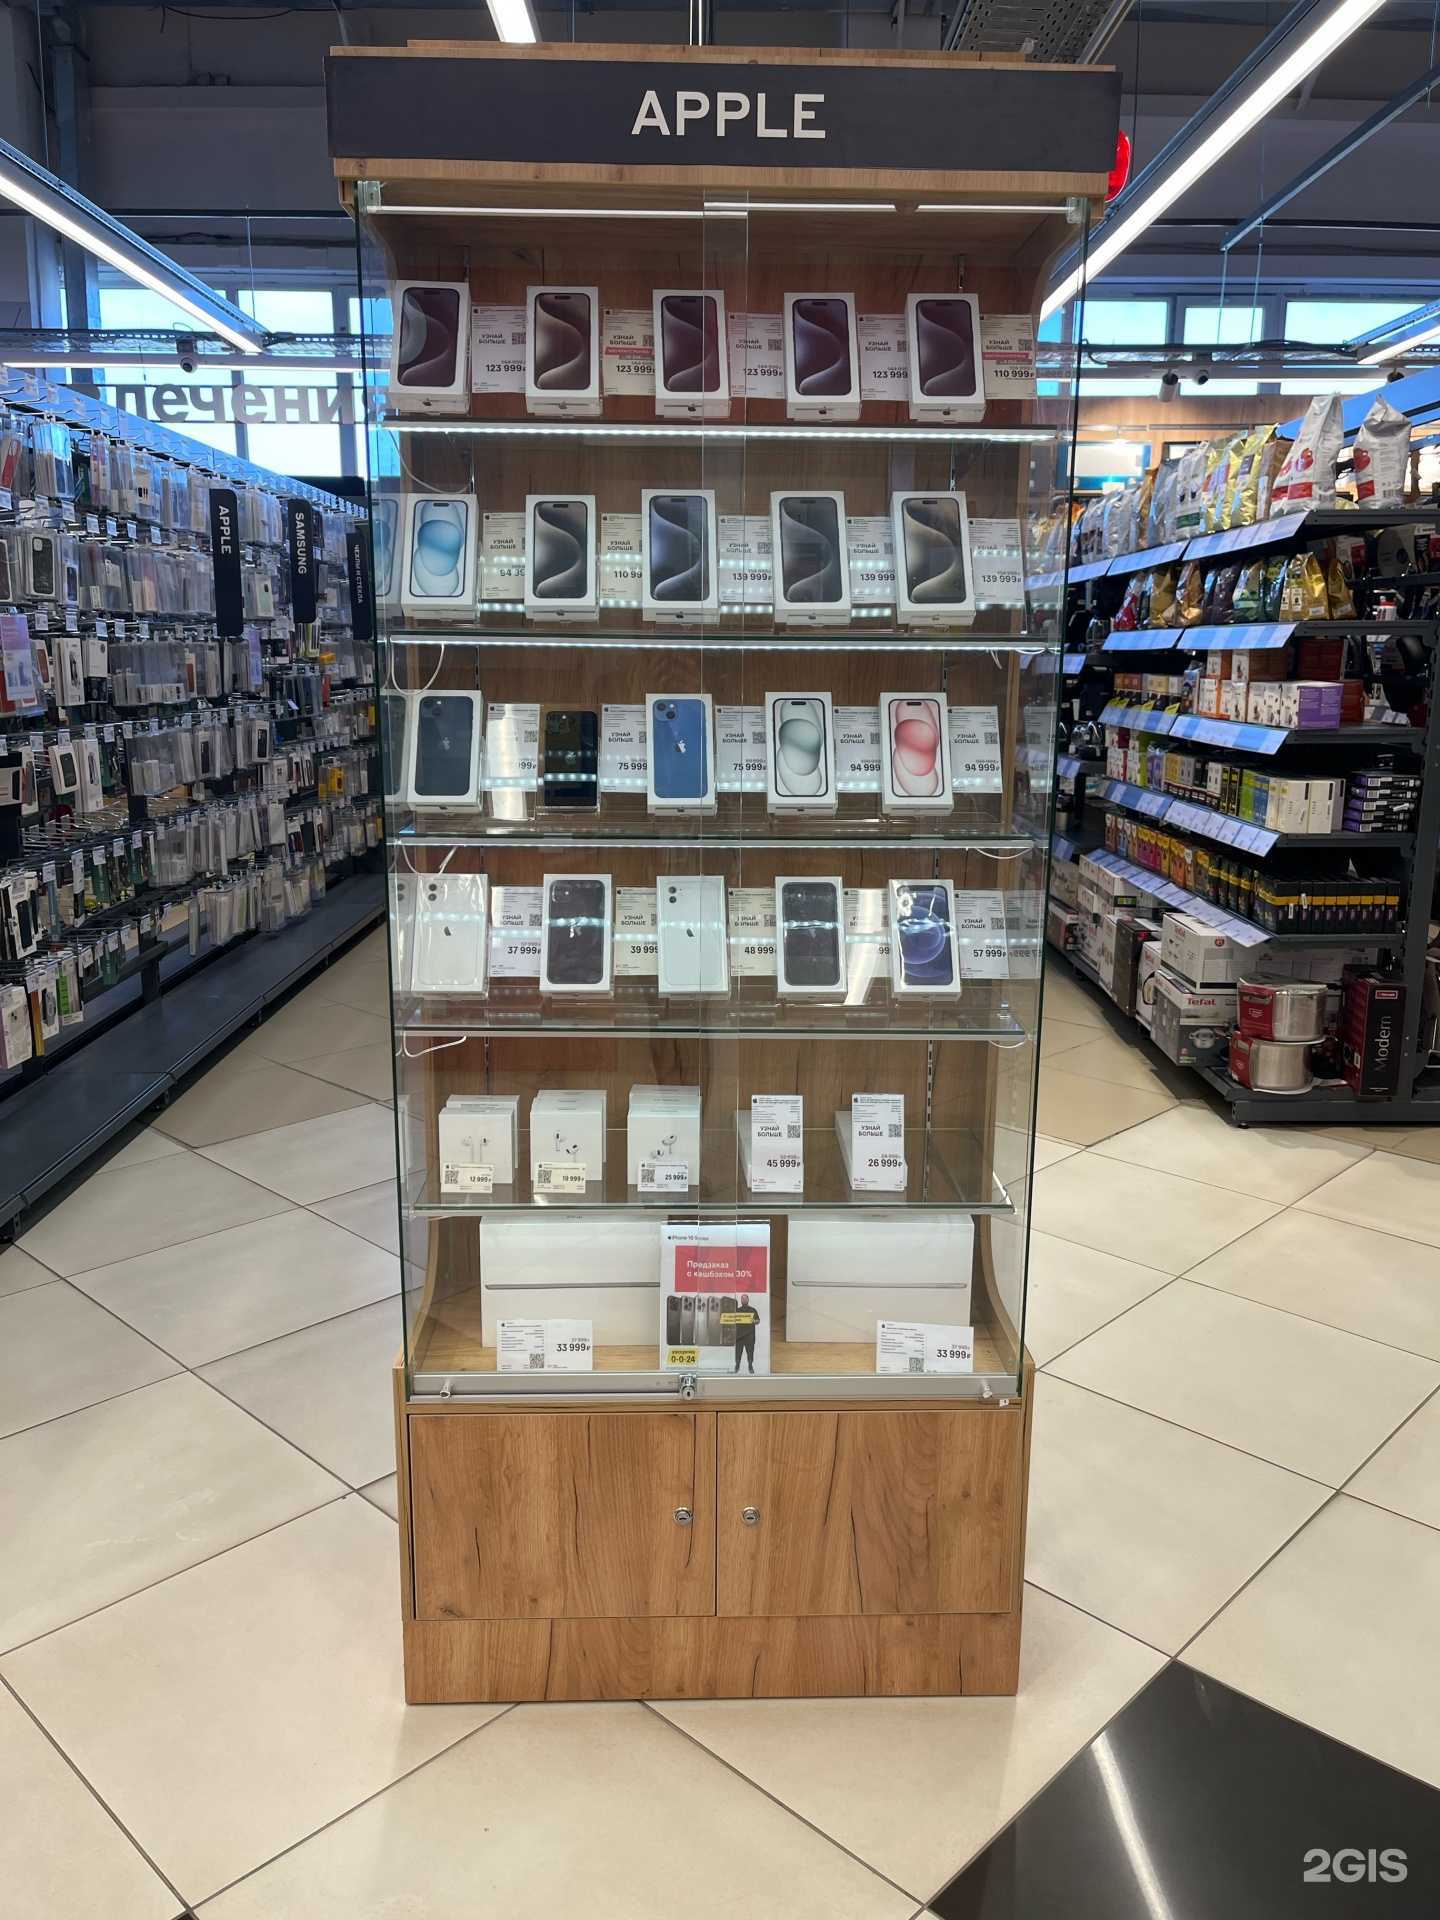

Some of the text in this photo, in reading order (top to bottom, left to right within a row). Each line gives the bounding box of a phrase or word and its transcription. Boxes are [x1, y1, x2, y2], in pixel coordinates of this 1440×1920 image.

[631, 90, 826, 139] APPLE
[486, 364, 501, 373] 123
[616, 365, 631, 373] 123
[743, 368, 758, 376] 123
[873, 371, 888, 379] 123
[218, 505, 232, 555] APPLE
[295, 512, 307, 575] SAMSUNG
[613, 570, 629, 578] 110
[732, 573, 748, 581] 139
[860, 573, 876, 581] 139
[982, 575, 997, 583] 139
[618, 762, 629, 771] 75
[733, 763, 744, 771] 75
[850, 763, 862, 771] 94
[965, 763, 977, 771] 94
[507, 946, 519, 954] 37
[631, 946, 643, 954] 39
[744, 947, 776, 956] 48 999
[973, 950, 984, 958] 57
[1187, 998, 1216, 1006] Tefal
[1375, 1015, 1392, 1072] Modern
[767, 1159, 778, 1168] 45
[868, 1159, 880, 1167] 26
[735, 1270, 752, 1278] 30%
[557, 1343, 568, 1352] 33
[937, 1349, 947, 1358] 33
[671, 1355, 696, 1364] 0-0-24
